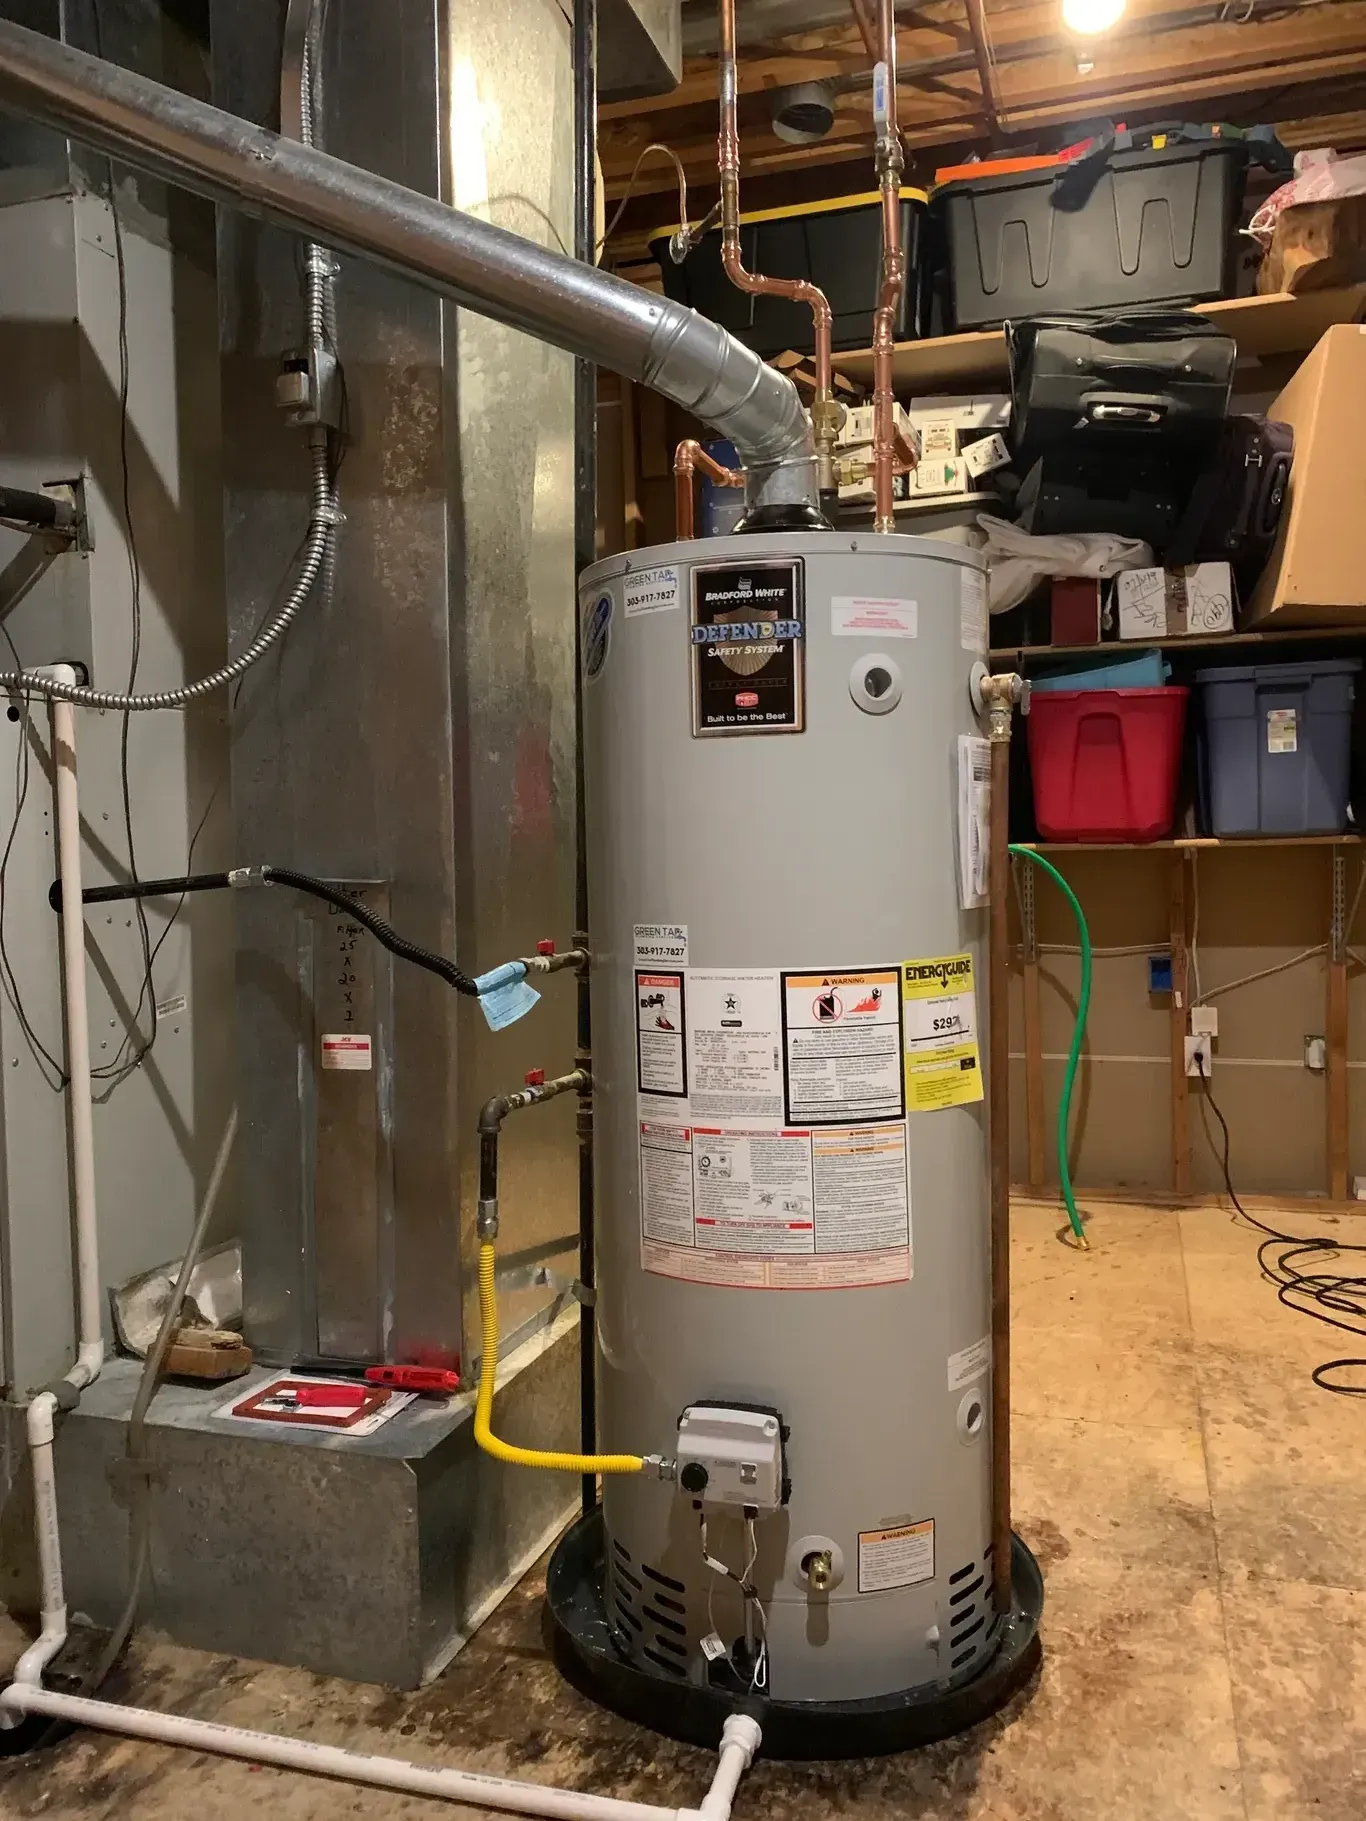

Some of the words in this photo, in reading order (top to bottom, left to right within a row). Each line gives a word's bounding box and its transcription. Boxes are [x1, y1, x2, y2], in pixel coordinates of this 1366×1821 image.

[624, 573, 651, 587] GREEN
[626, 590, 675, 607] 303-917-7827
[705, 590, 753, 601] BRADFORD
[754, 588, 785, 598] WHITE
[692, 620, 802, 643] DEFENDER
[707, 647, 742, 657] SAFETY
[743, 645, 783, 655] SYSTEM
[707, 714, 725, 723] Built
[765, 712, 786, 720] Best
[634, 926, 661, 936] GREEN
[662, 927, 681, 937] TAP
[339, 940, 358, 952] 25
[637, 946, 685, 956] 303-917-7827
[337, 972, 356, 985] 20
[830, 977, 865, 985] WARNING
